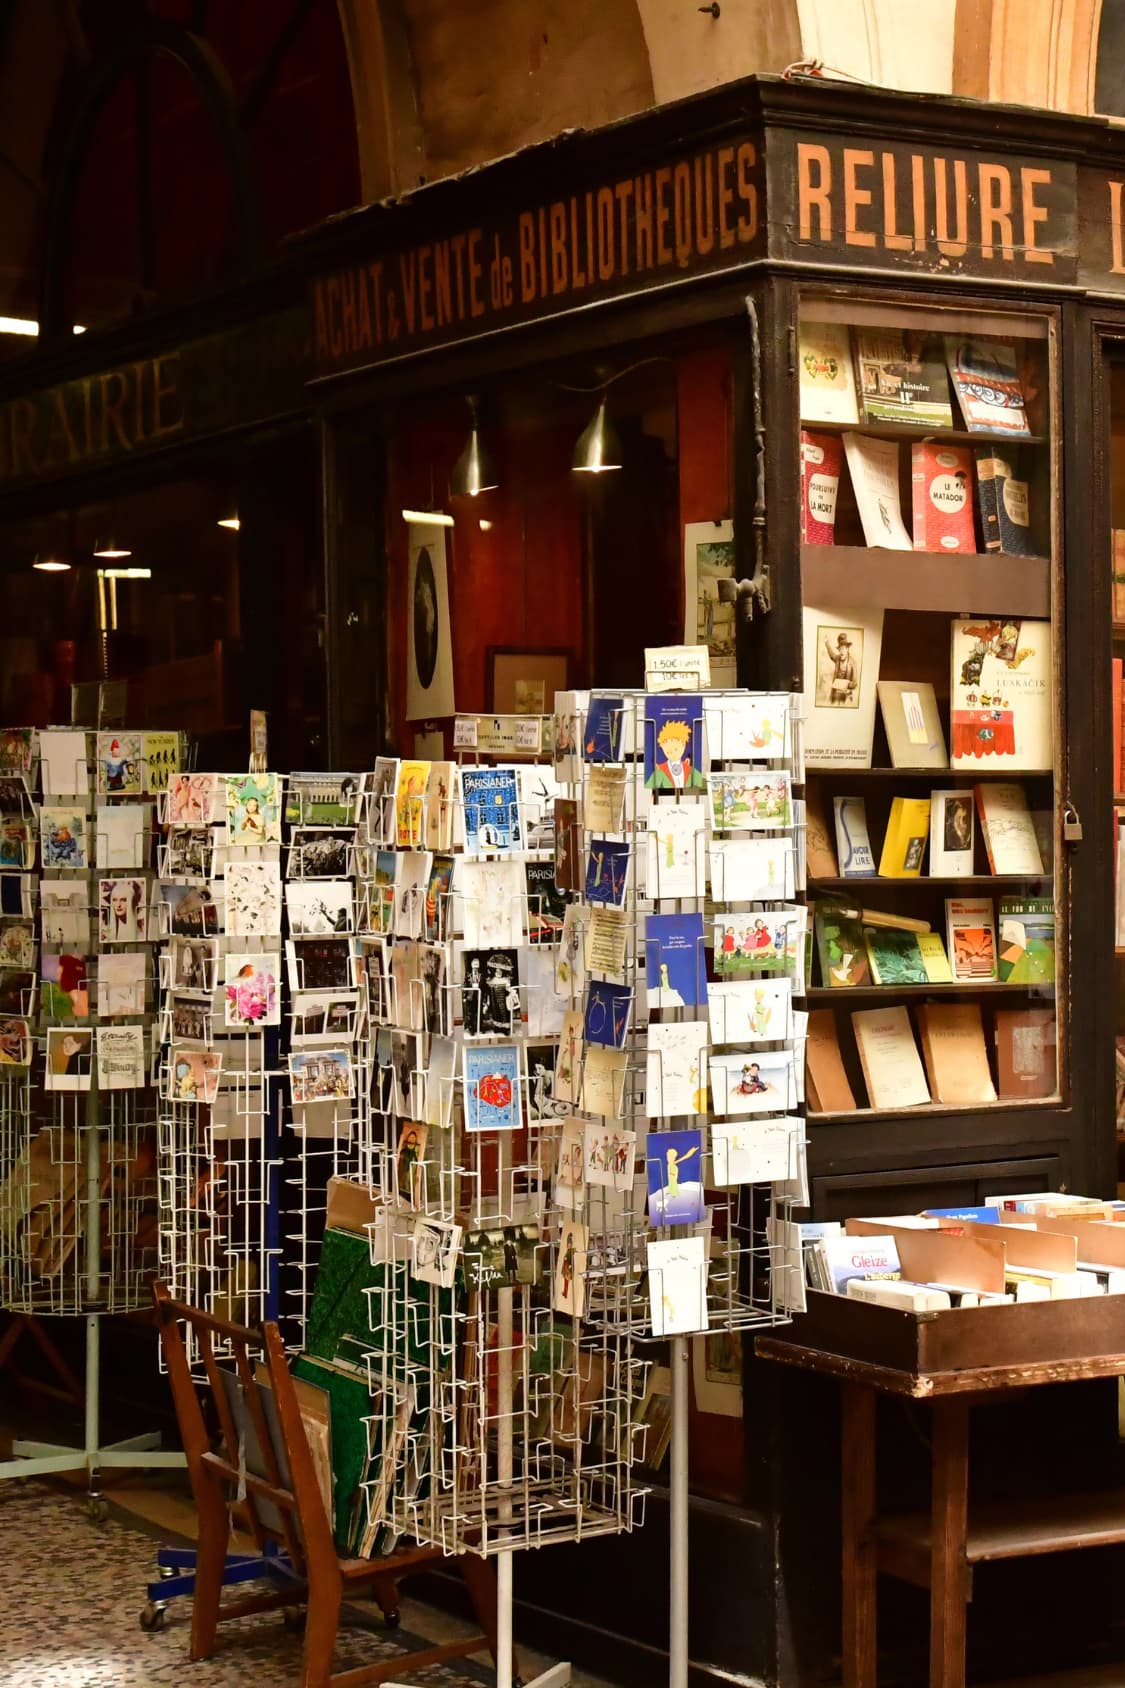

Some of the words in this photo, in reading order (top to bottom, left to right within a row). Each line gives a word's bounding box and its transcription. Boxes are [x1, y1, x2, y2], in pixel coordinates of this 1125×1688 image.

[797, 143, 1054, 265] RELIURE
[315, 260, 384, 360] ACHAT
[401, 228, 485, 335] VENTE
[490, 231, 513, 311] de
[519, 142, 757, 301] BIBLIOTHEQUES
[944, 482, 951, 491] LE
[933, 492, 963, 502] MATADOR
[817, 502, 833, 514] MORT
[464, 776, 513, 789] PARISIANER
[468, 1055, 514, 1065] PARISIANER
[851, 1254, 888, 1269] Gleize
